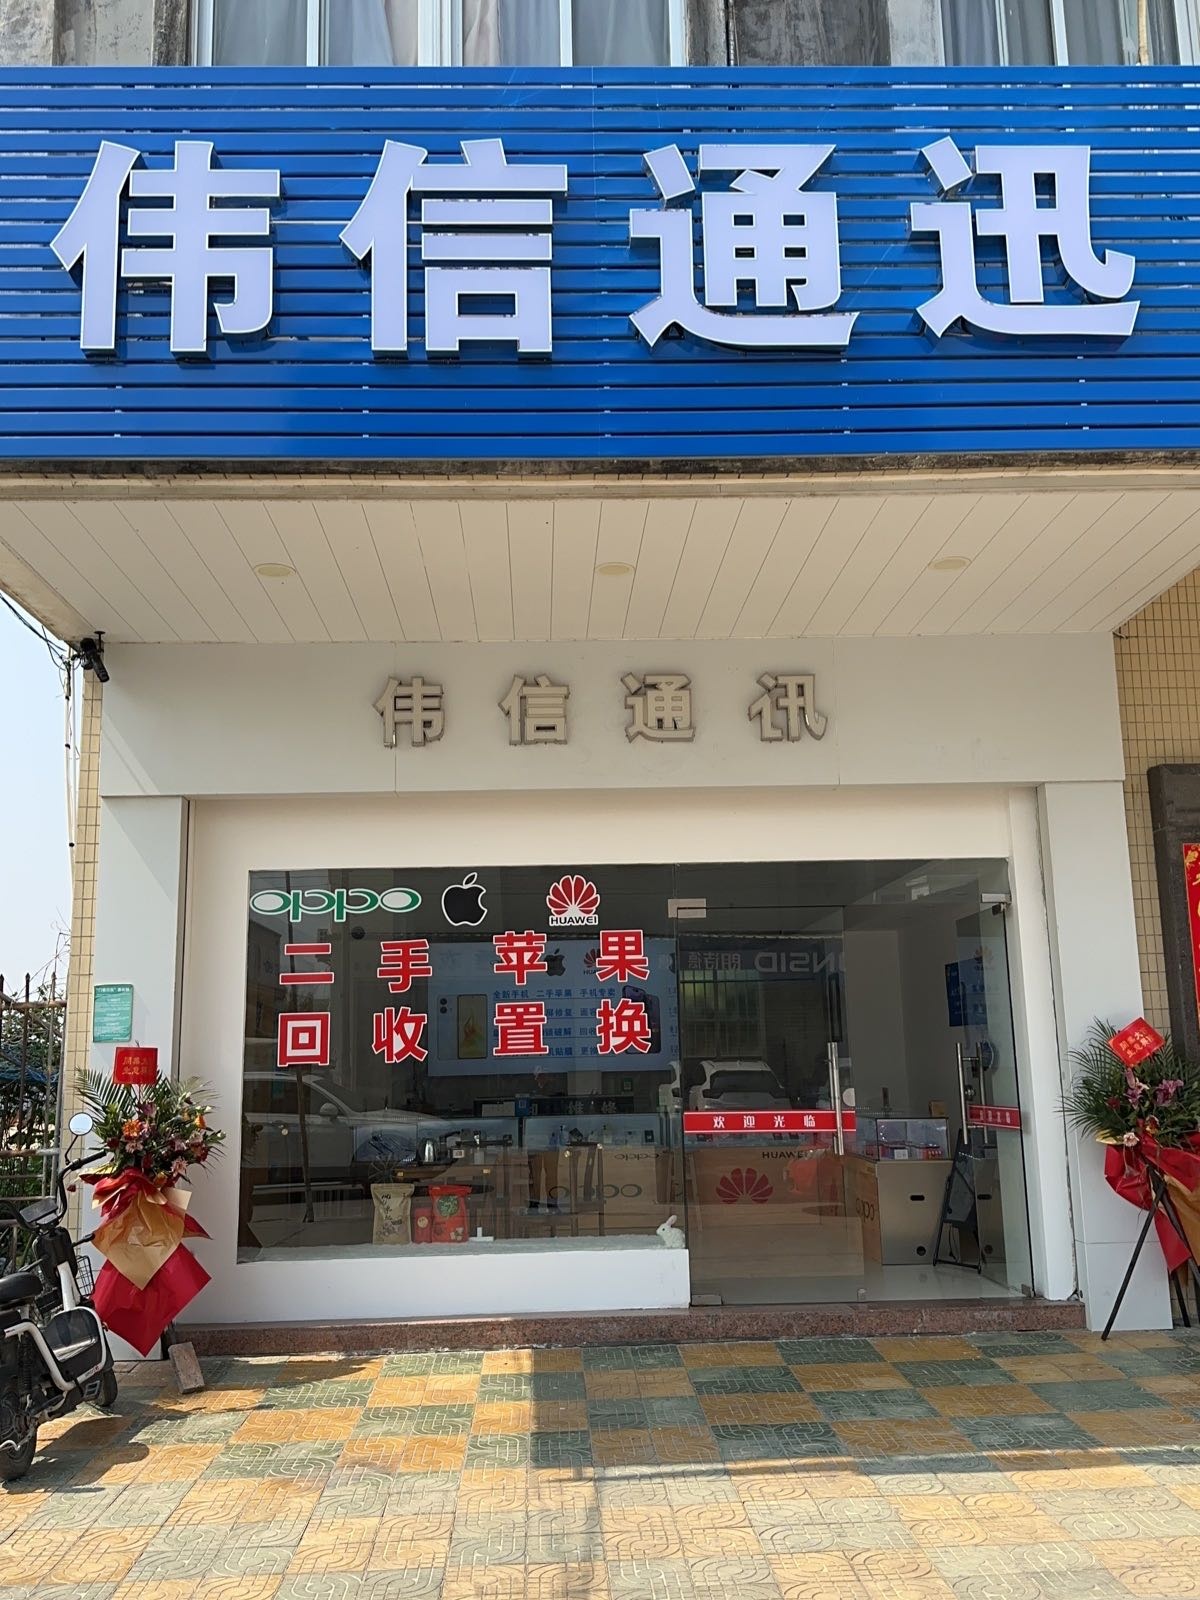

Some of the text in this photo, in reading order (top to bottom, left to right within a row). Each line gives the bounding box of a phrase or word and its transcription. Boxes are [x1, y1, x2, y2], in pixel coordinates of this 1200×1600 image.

[49, 138, 1142, 356] 伟信通迅
[372, 671, 829, 748] 伟信通讯
[549, 914, 599, 927] HUAWEI
[279, 929, 651, 994] 二手苹果
[277, 998, 652, 1067] 回收置换
[712, 1114, 817, 1129] 欢迎光临
